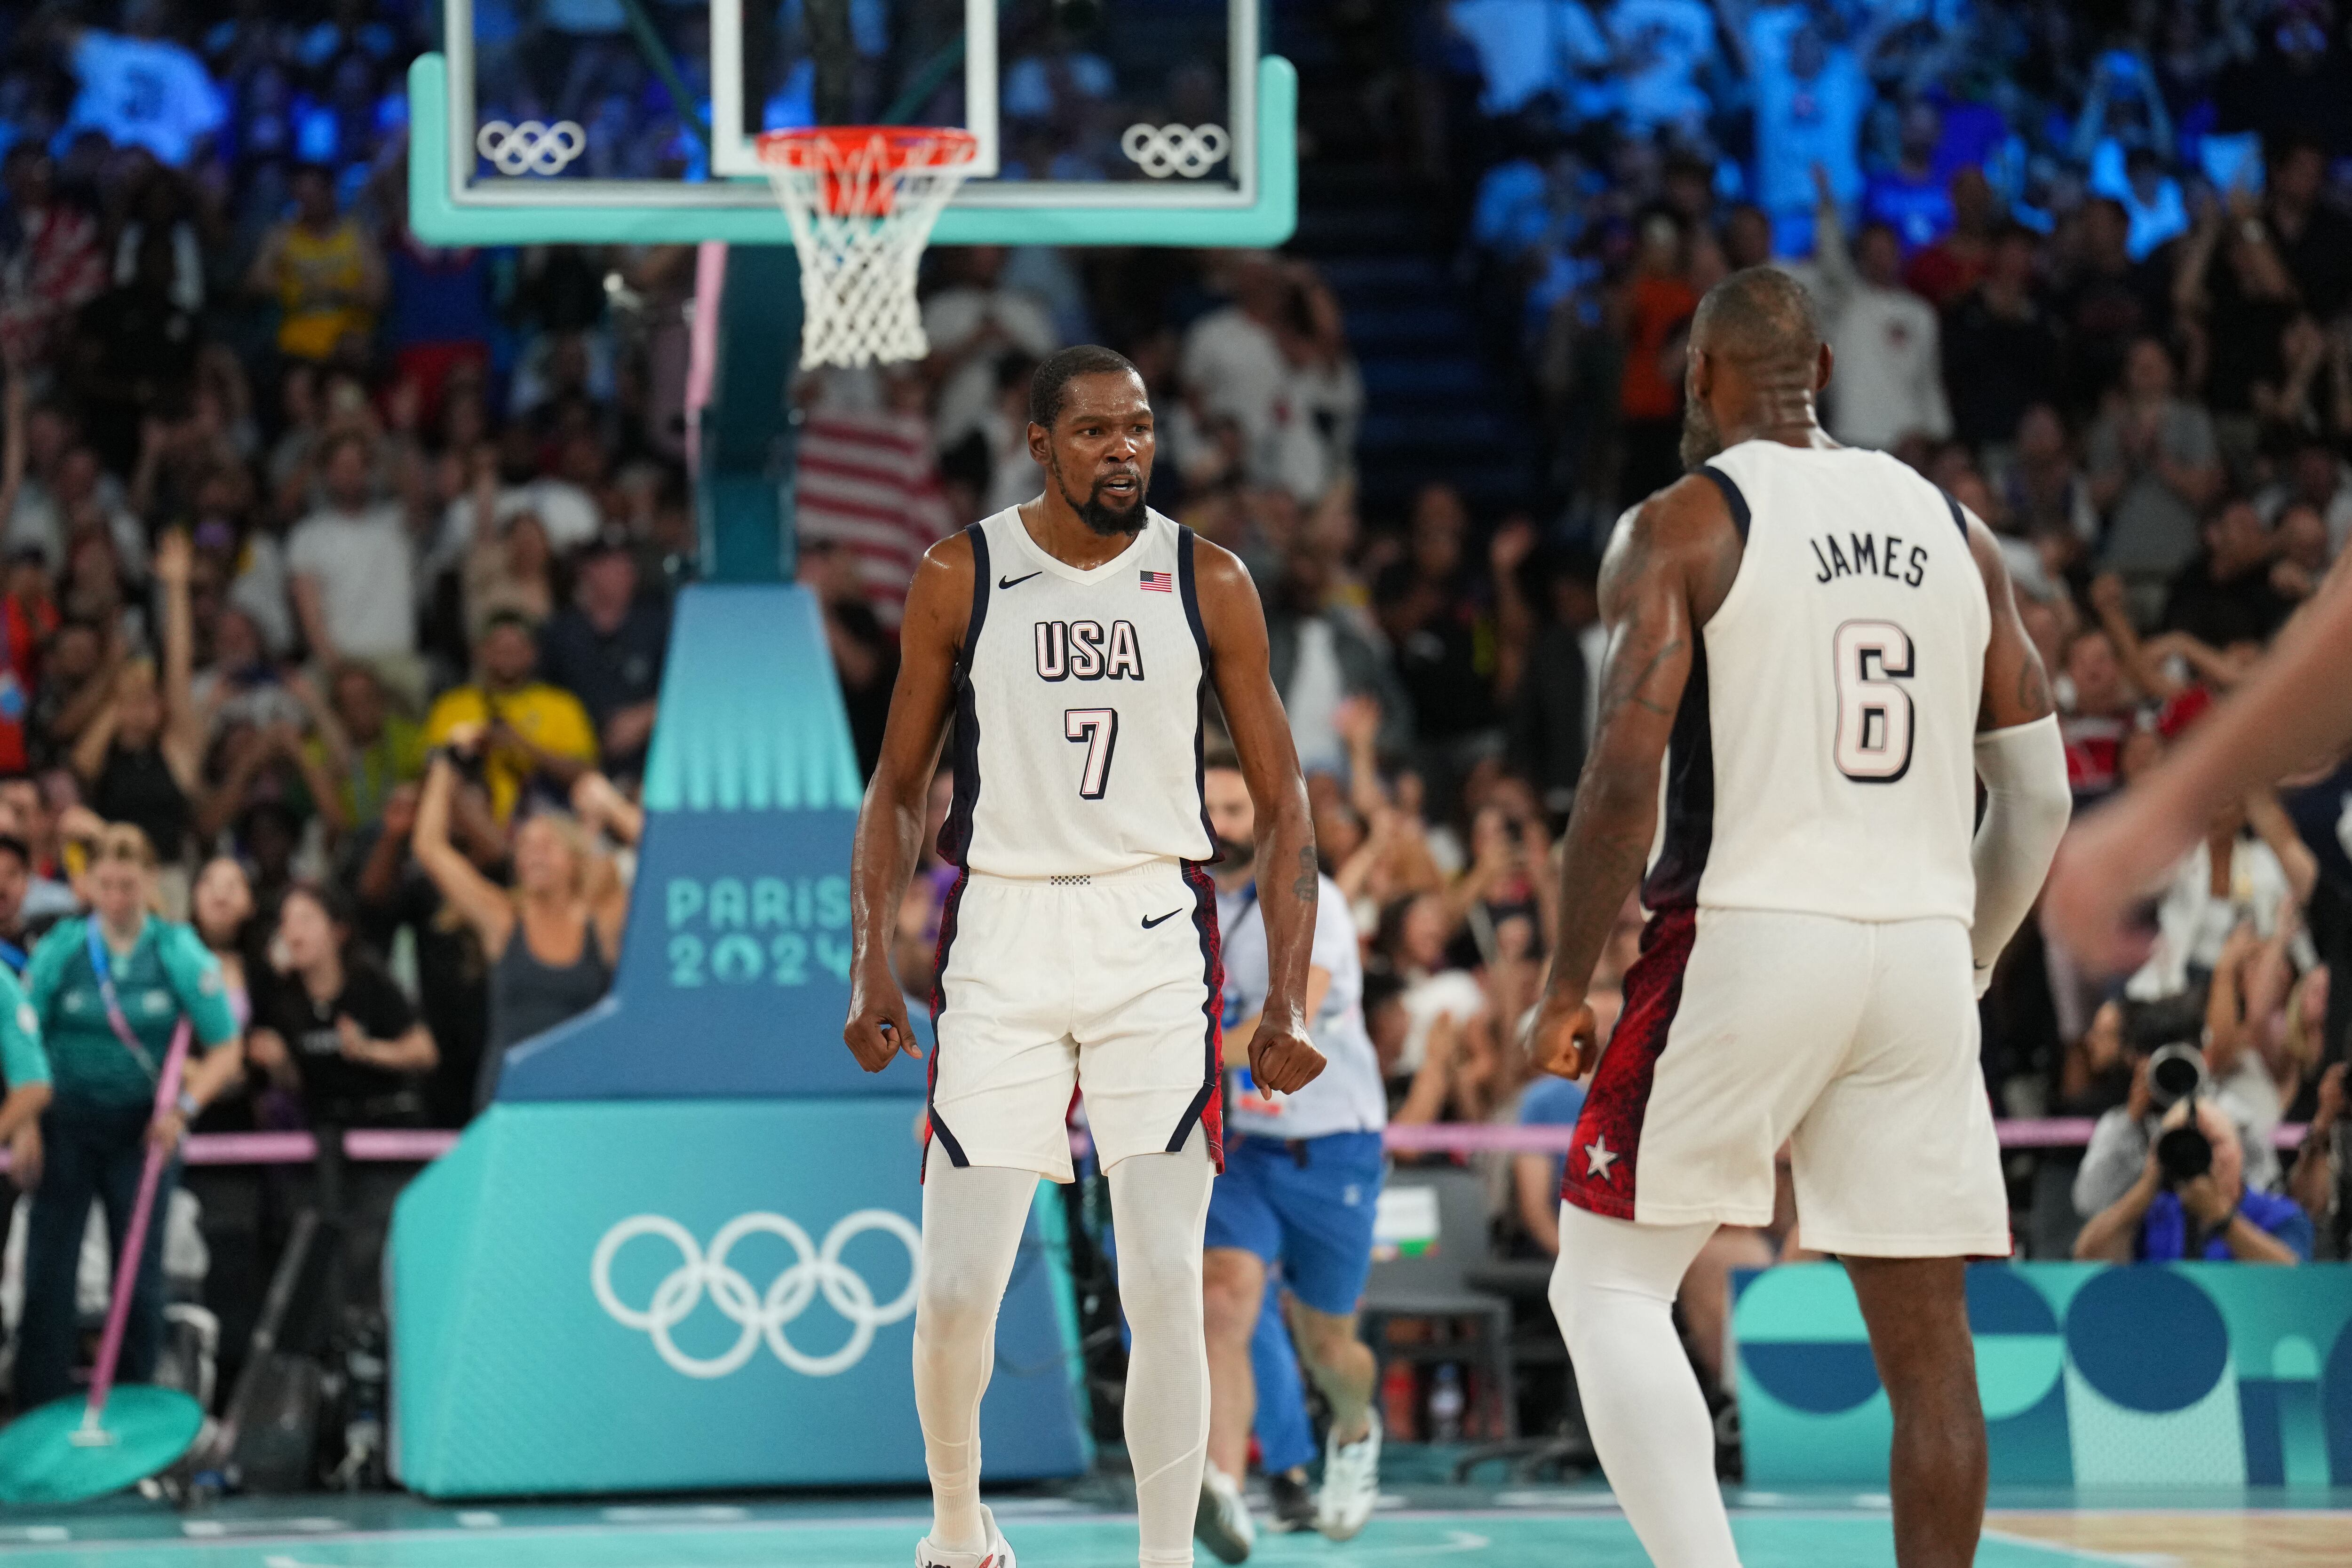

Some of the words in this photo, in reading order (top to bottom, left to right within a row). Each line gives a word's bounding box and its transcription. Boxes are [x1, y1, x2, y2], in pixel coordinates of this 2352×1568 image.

[1811, 532, 1927, 588] JAMES
[1034, 620, 1144, 681] USA
[1833, 618, 1915, 783] 6
[1065, 708, 1118, 800] 7
[665, 876, 851, 930] PARIS
[667, 931, 852, 987] 2024
